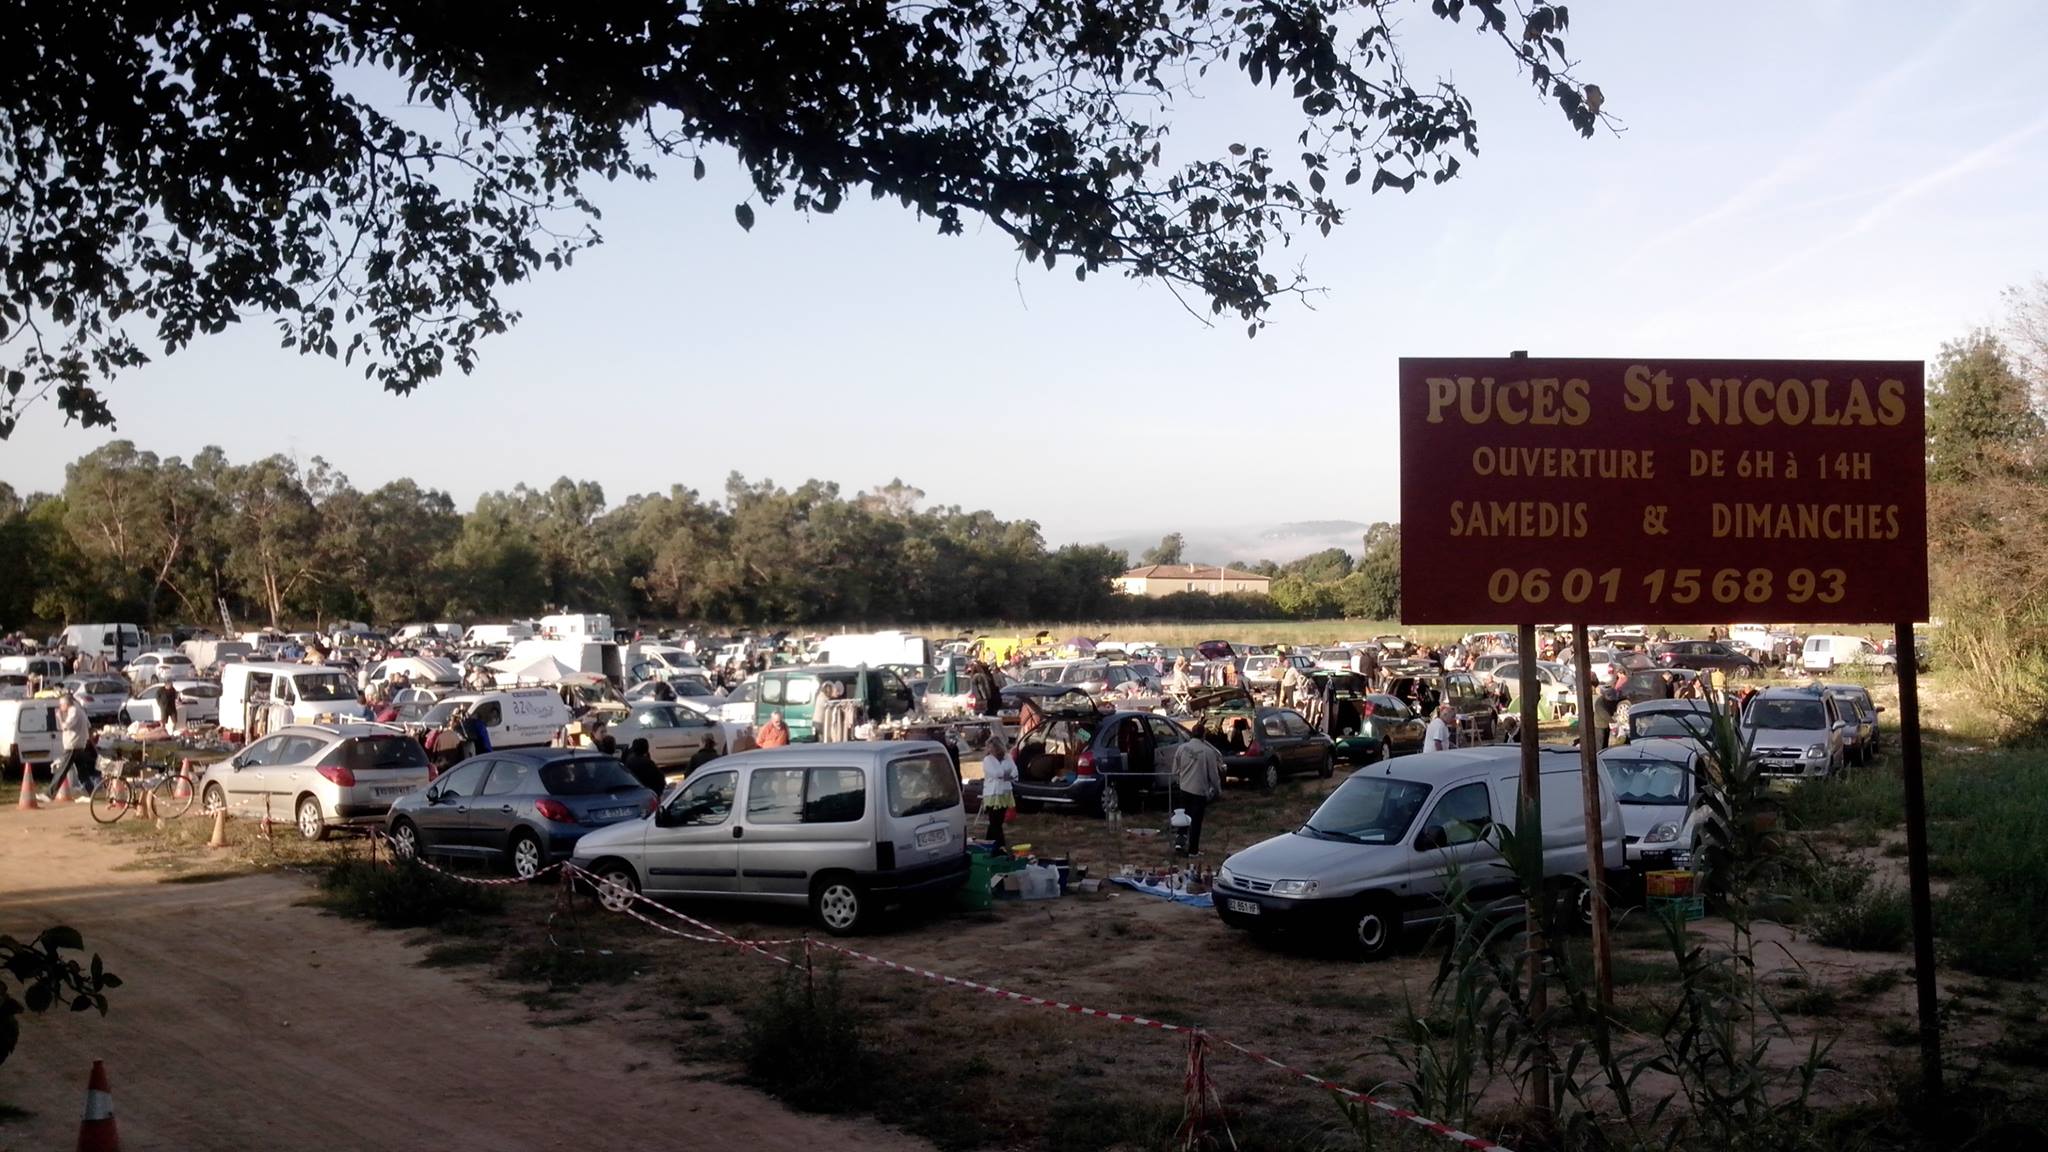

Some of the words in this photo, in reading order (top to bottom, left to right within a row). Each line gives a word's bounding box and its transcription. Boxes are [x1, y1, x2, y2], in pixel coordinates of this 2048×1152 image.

[1424, 376, 1591, 426] PUCES
[1623, 364, 1674, 412] St
[1686, 377, 1906, 426] NICOLAS
[1472, 446, 1655, 479] OUVERTURE
[1690, 449, 1724, 478] DE
[1737, 450, 1774, 479] 6H
[1784, 451, 1798, 479] à
[1819, 453, 1871, 480] 14H
[1449, 501, 1588, 537] SAMEDIS
[1643, 505, 1669, 535] &
[1712, 504, 1900, 539] DIMANCHES
[1488, 568, 1550, 603] 06
[1562, 568, 1621, 603] 01
[1642, 568, 1701, 603] 15
[1712, 568, 1773, 603] 68
[1787, 568, 1846, 603] 93
